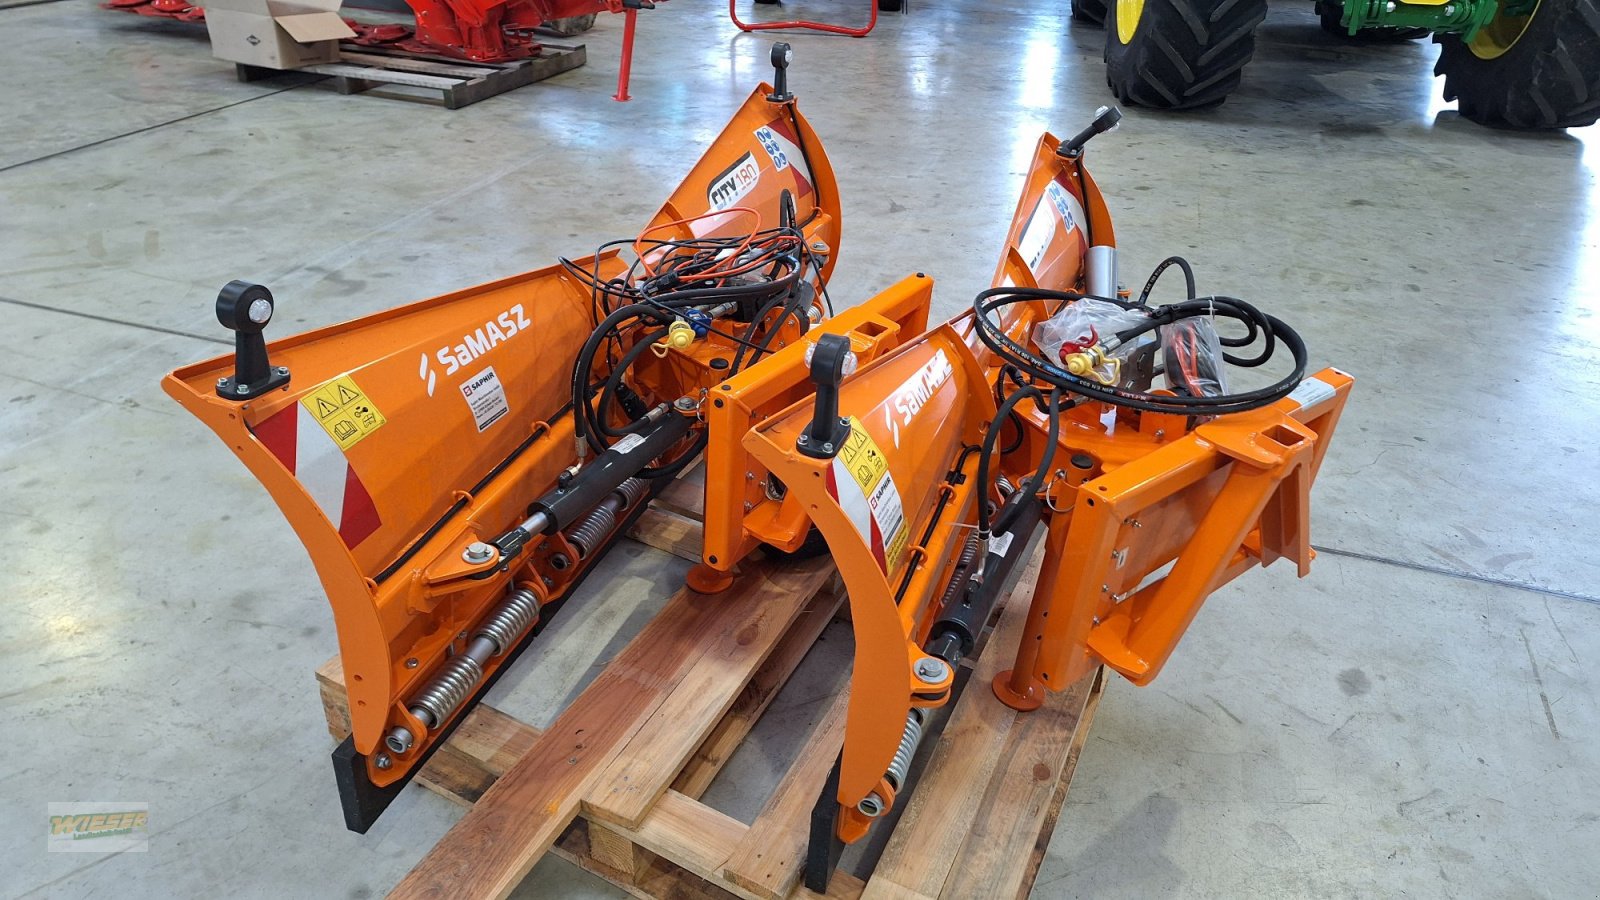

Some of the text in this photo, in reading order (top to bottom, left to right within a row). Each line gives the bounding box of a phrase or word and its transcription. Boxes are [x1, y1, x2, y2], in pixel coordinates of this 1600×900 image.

[436, 303, 531, 376] SaMASZ
[471, 371, 495, 391] SAPHIR
[874, 476, 892, 502] SAPHIR
